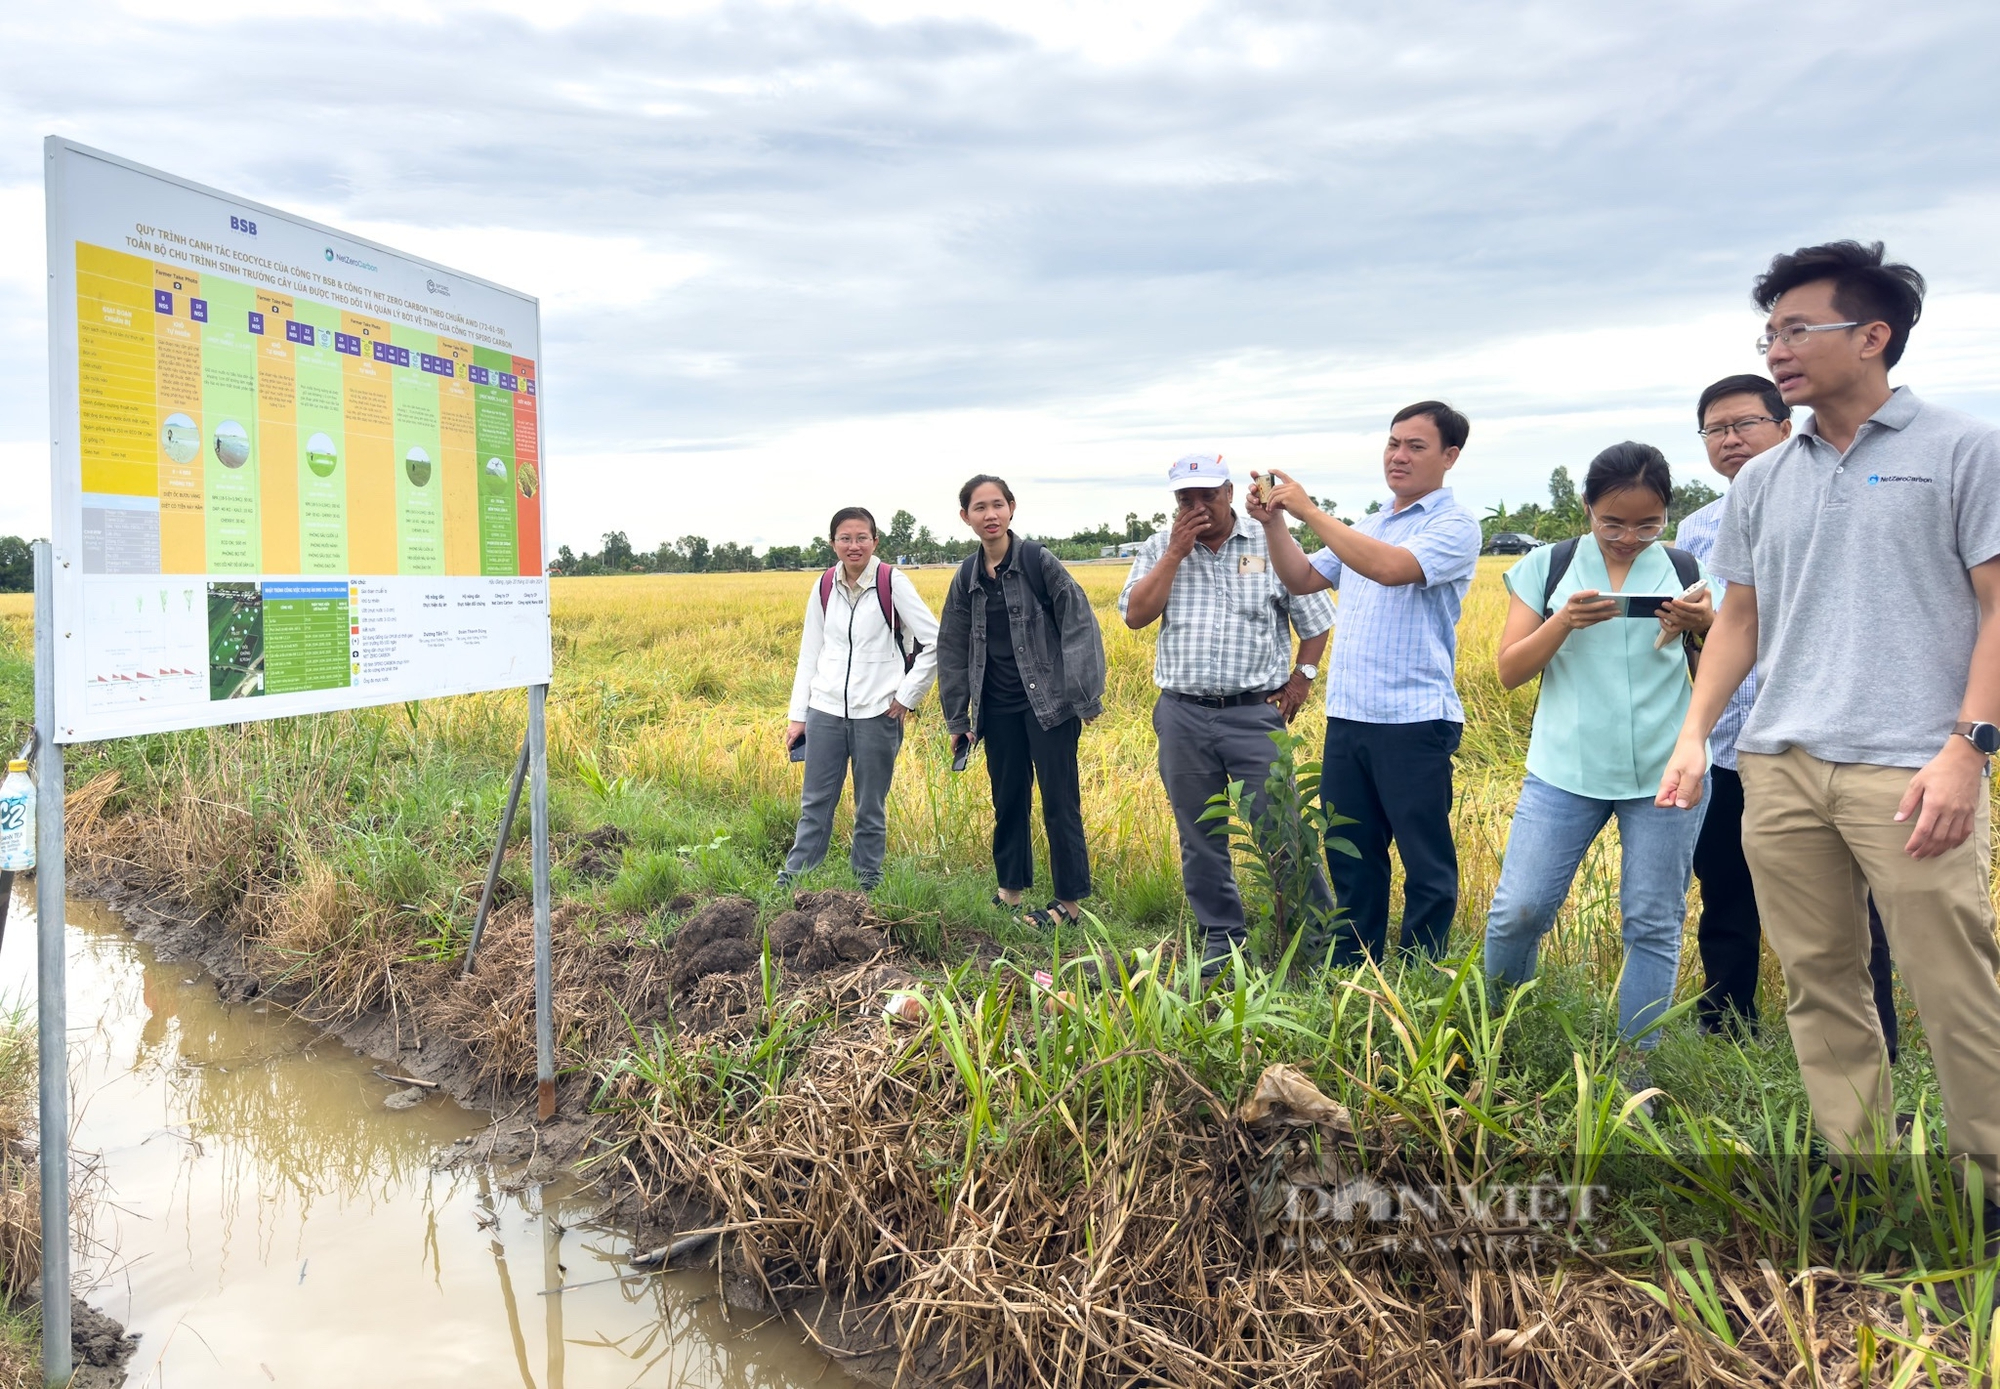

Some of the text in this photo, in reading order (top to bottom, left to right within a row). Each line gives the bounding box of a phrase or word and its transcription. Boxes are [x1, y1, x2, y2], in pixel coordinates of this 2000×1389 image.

[230, 216, 257, 235] BSB
[136, 223, 155, 236] QUY
[158, 229, 187, 245] TRÌNH
[189, 238, 212, 252] CANH
[215, 244, 230, 257] TÁC
[233, 251, 272, 269] ECOCYCLE
[274, 260, 289, 274] CỦA
[290, 266, 311, 280] CÔNG
[313, 273, 321, 282] TY
[323, 276, 336, 287] BSB
[344, 281, 362, 295] CÔNG
[364, 288, 372, 297] TY
[374, 291, 385, 301] NET
[387, 294, 403, 306] ZERO
[404, 300, 428, 313] CARBON
[429, 307, 444, 318] THEO
[445, 312, 464, 324] CHUẨN
[465, 318, 478, 328] AWD
[479, 322, 505, 337] (72-61-58)
[156, 269, 172, 278] Farmer
[126, 236, 151, 251] TOÀN
[154, 243, 166, 257] BỘ
[169, 249, 187, 261] CHU
[190, 254, 217, 269] TRÌNH
[220, 262, 240, 275] SINH
[277, 277, 292, 289] CÂY
[294, 281, 308, 293] LÚA
[309, 287, 329, 299] ĐƯỢC
[331, 292, 348, 304] THEO
[364, 301, 372, 311] VÀ
[374, 304, 392, 316] QUẢN
[393, 308, 400, 318] LÝ
[423, 317, 438, 329] TINH
[439, 321, 450, 332] CỦA
[451, 325, 467, 336] CÔNG
[468, 330, 475, 339] TY
[475, 333, 491, 344] SPIRO
[492, 337, 512, 349] CARBON
[1880, 475, 1933, 484] NetZeroCarbon
